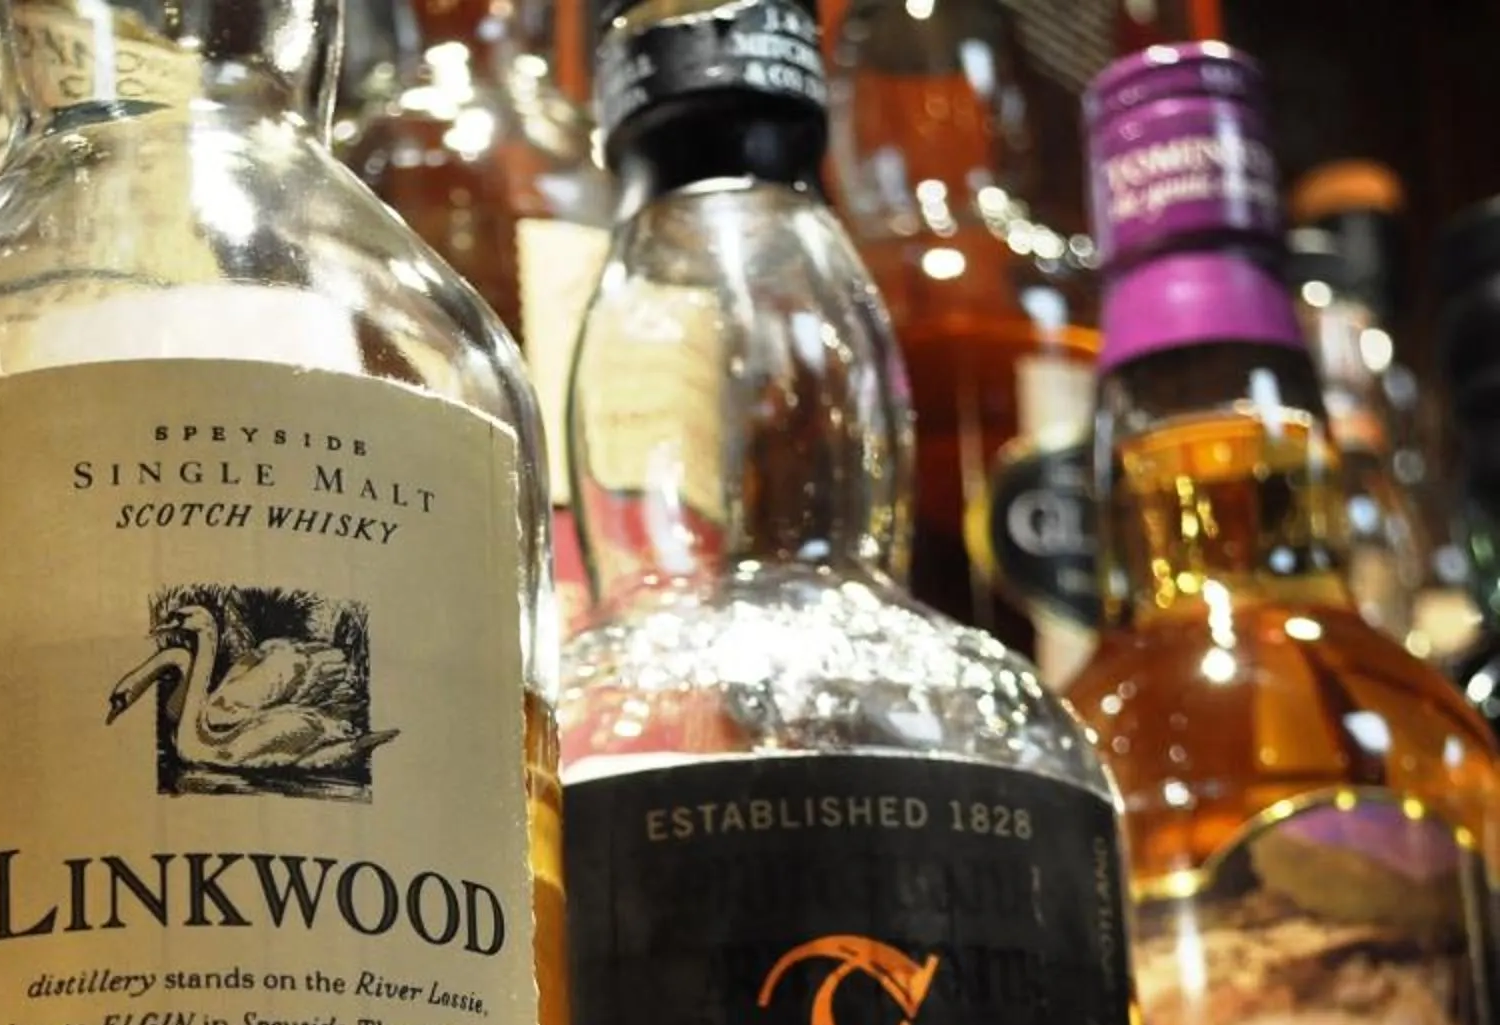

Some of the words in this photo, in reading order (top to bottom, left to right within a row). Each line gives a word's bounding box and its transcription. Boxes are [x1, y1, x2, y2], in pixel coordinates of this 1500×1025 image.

[155, 426, 366, 456] SPEYSIDE
[74, 462, 274, 489] SINGLE
[314, 465, 434, 512] MALT
[116, 503, 251, 528] SCOTCH
[268, 506, 397, 544] WHISKY
[646, 798, 929, 842] ESTABLISHED
[950, 801, 1032, 840] 1828
[28, 970, 156, 998] distillery
[165, 967, 254, 989] stands
[264, 975, 296, 990] on
[306, 971, 345, 994] the
[356, 971, 422, 1000] River
